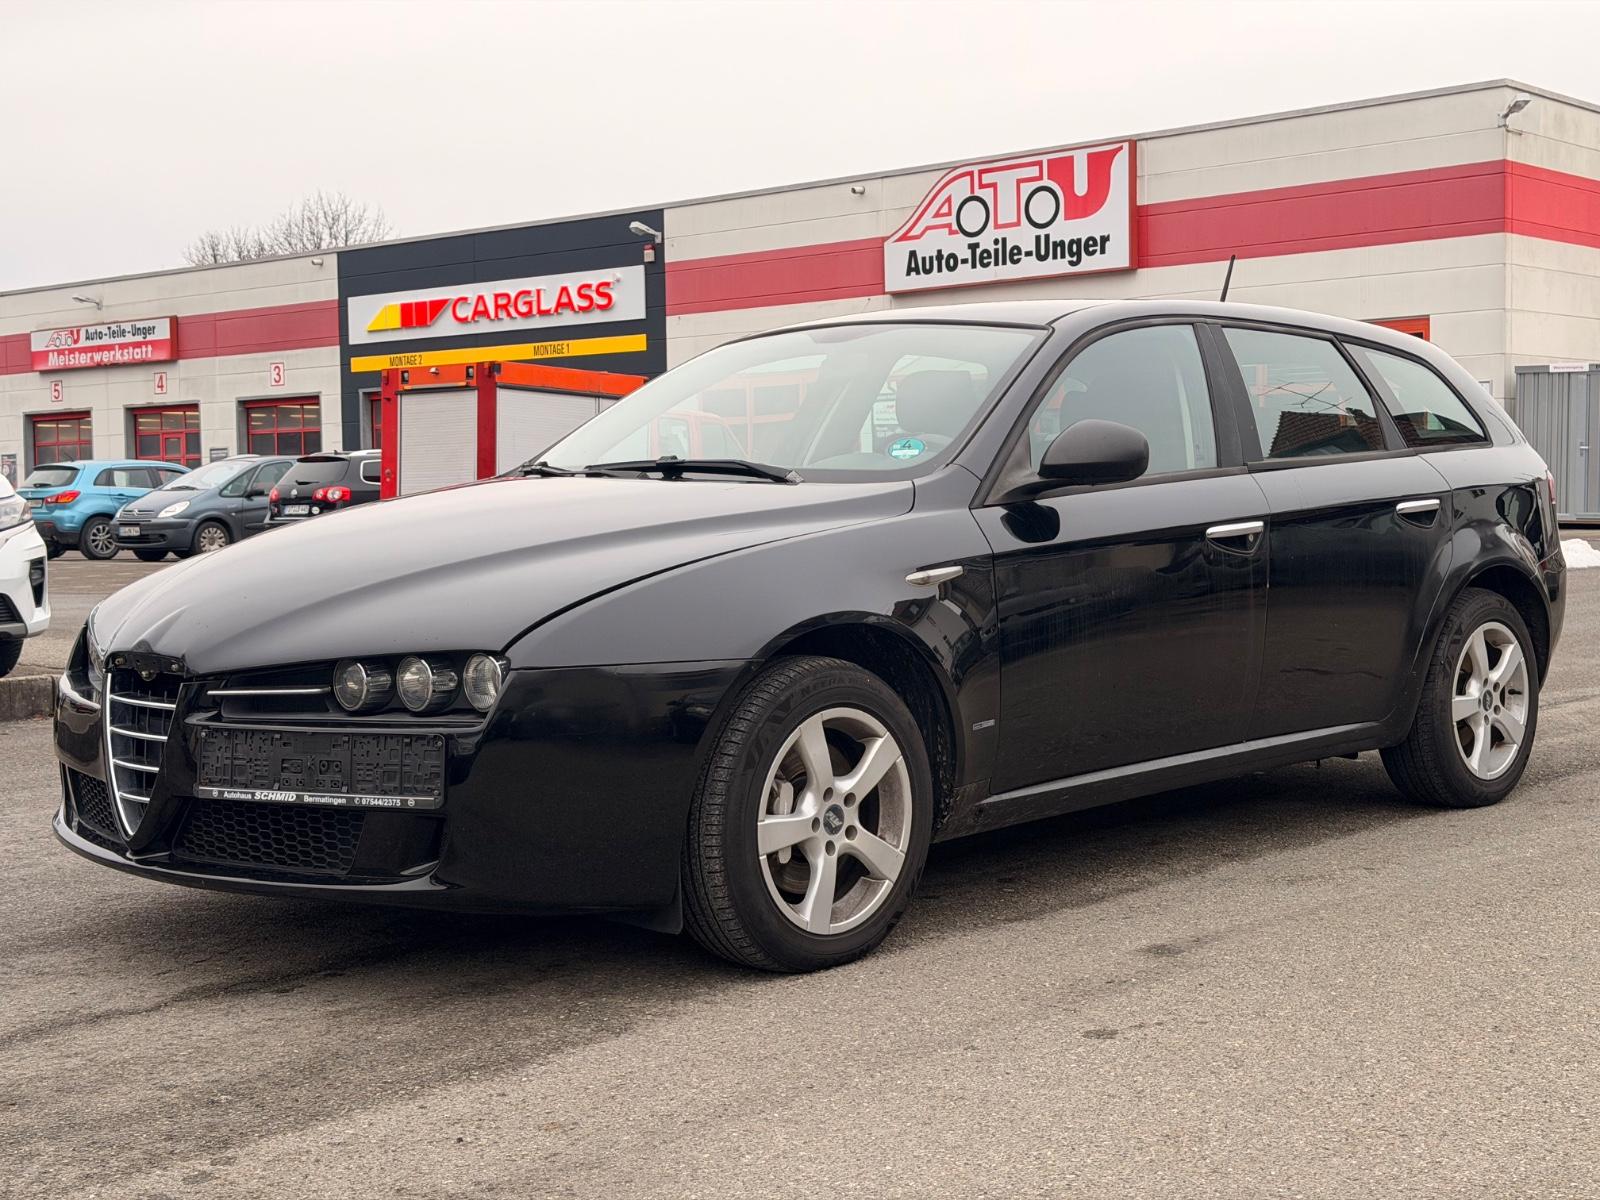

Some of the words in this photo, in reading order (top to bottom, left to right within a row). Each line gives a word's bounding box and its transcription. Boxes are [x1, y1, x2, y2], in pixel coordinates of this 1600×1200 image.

[905, 233, 1110, 276] Auto-Teile-Unger
[451, 281, 613, 322] CARGLASS
[85, 325, 156, 341] Auto-Teile-Unger
[48, 345, 153, 367] Meisterwerkstatt
[533, 344, 565, 357] MONTAGE
[566, 343, 570, 353] 1
[389, 355, 417, 367] MONTAGE
[418, 354, 423, 365] 2
[156, 374, 164, 391] 4
[273, 365, 281, 384] 3
[53, 385, 61, 400] 5
[902, 439, 912, 449] 4
[223, 791, 252, 800] Autohaus
[253, 791, 297, 802] SCHMID
[303, 795, 347, 806] Bermatingen
[361, 798, 401, 807] 07544/2375
